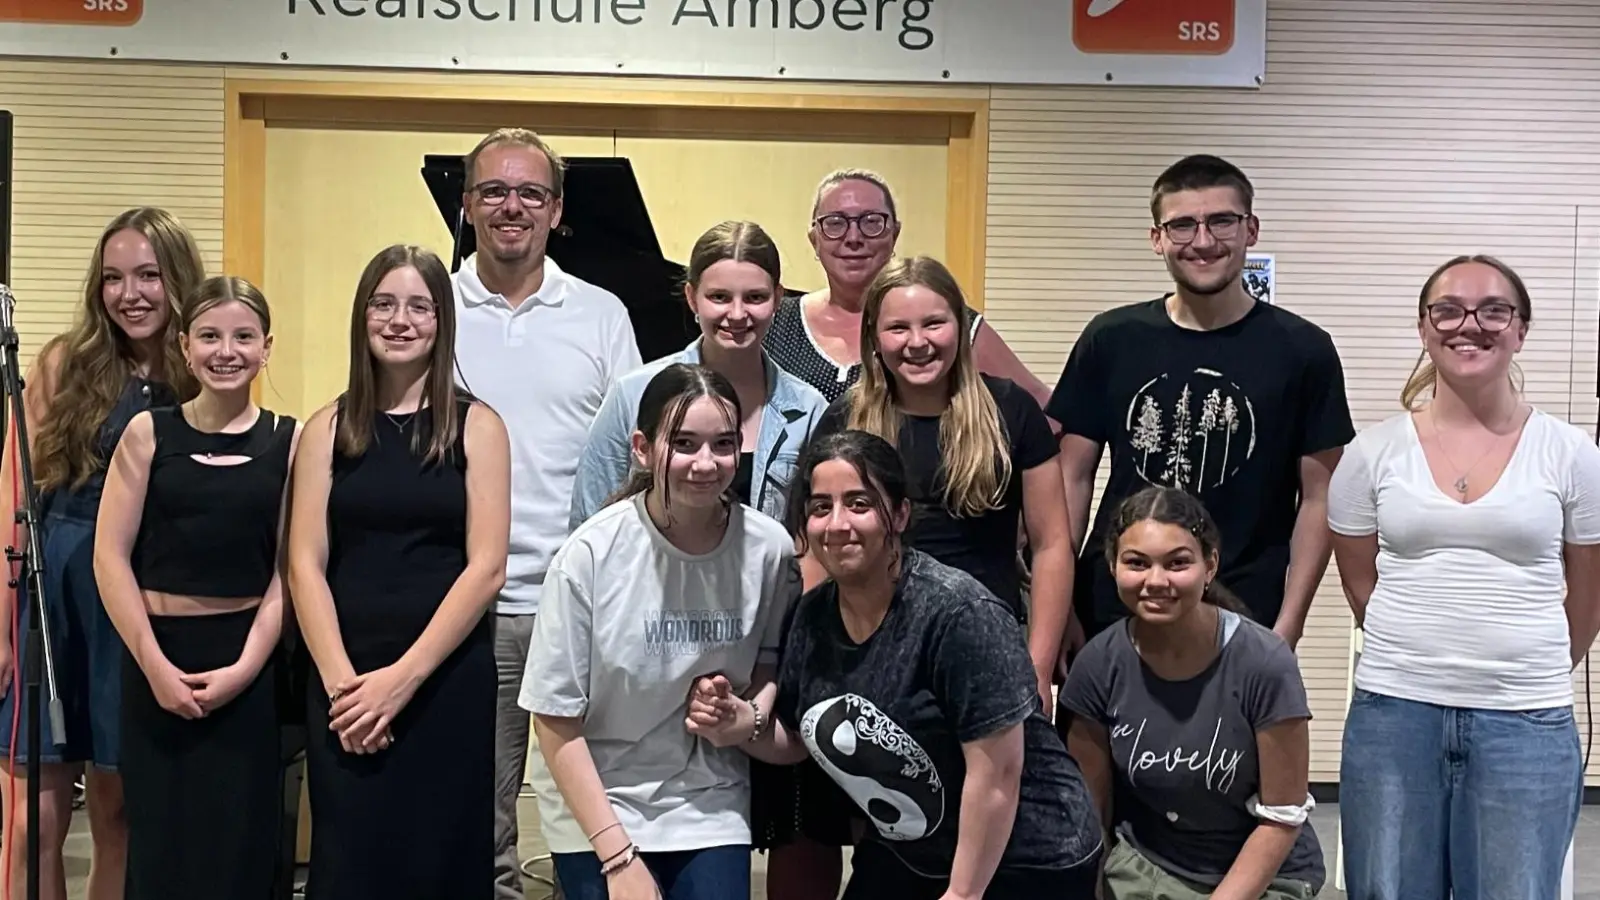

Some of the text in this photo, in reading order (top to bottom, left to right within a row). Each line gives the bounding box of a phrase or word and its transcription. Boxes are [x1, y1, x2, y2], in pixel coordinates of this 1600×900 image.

[671, 0, 934, 50] Amberg
[1178, 21, 1220, 41] SRS
[643, 618, 744, 642] WONDROUS
[1128, 717, 1245, 794] lovely
